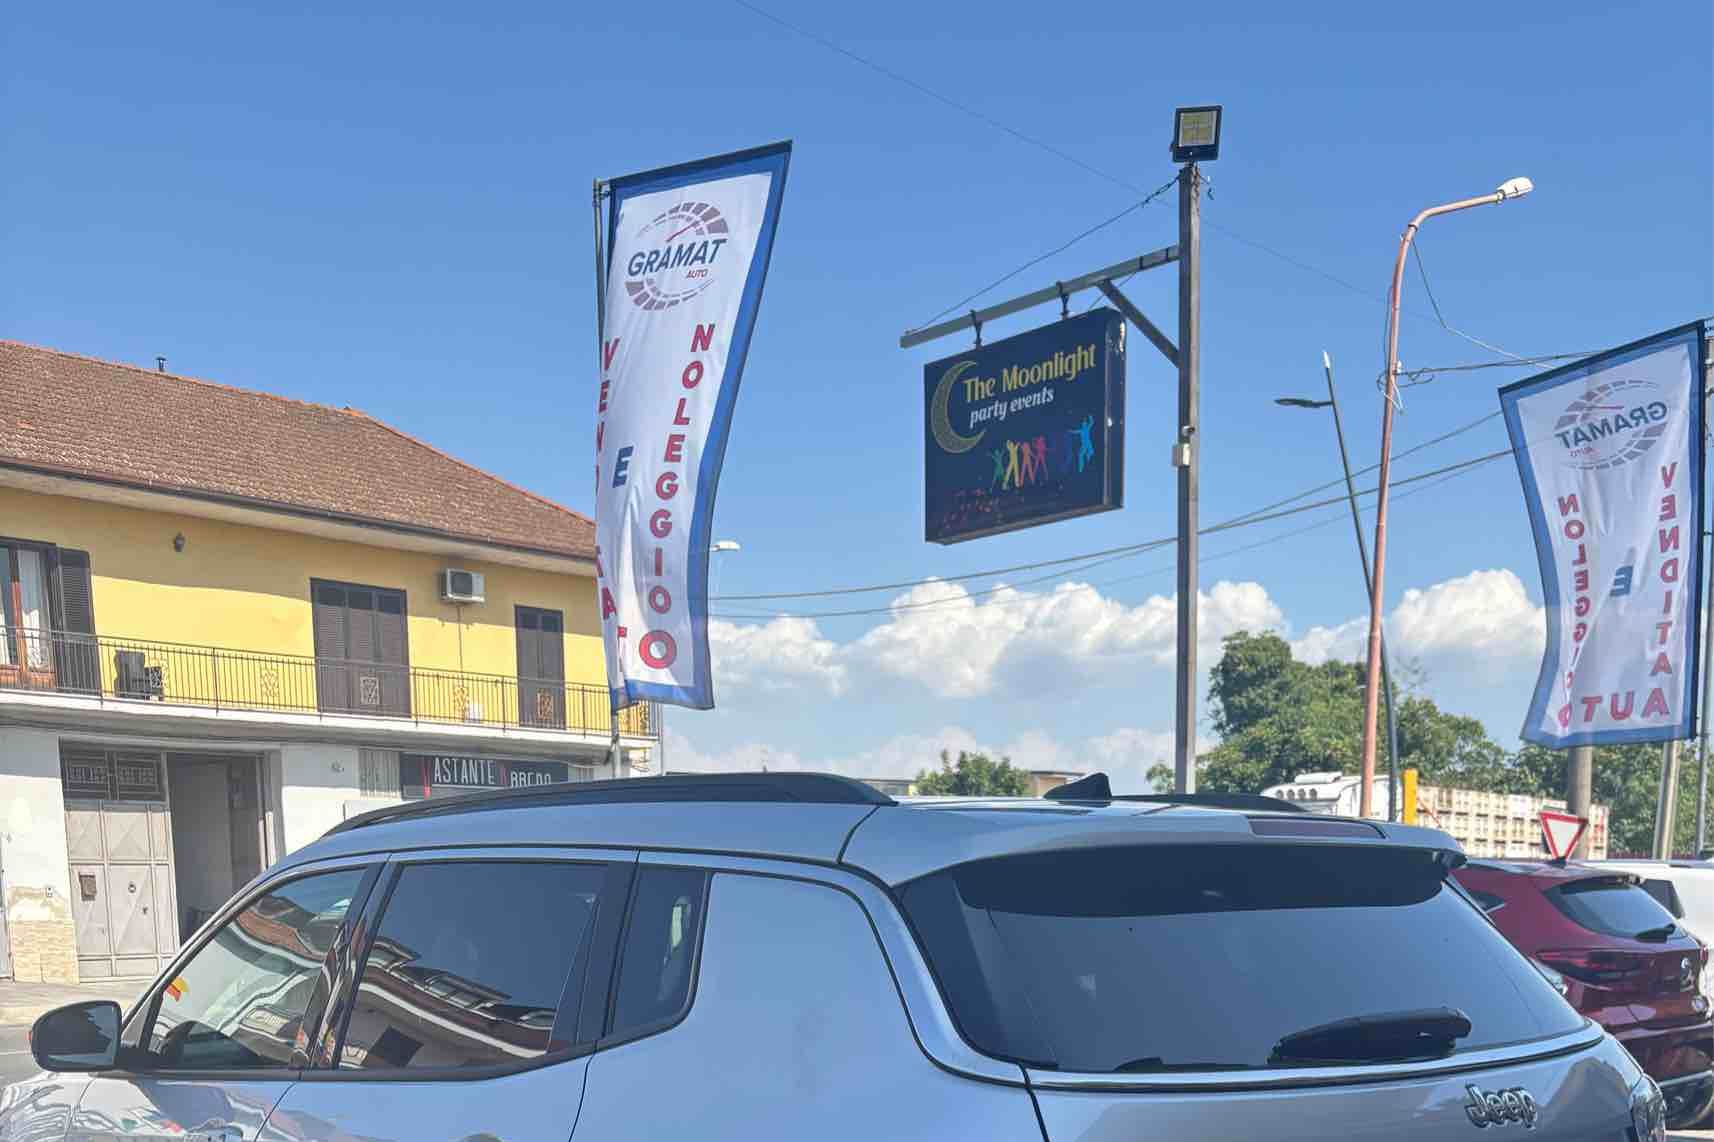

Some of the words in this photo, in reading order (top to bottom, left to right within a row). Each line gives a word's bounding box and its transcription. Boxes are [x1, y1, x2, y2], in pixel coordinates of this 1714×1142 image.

[627, 238, 727, 277] GRAMAT
[686, 267, 709, 280] AUTO
[963, 376, 996, 403] The
[1001, 343, 1096, 392] Moonlight
[970, 399, 1009, 429] party
[1010, 386, 1054, 413] events
[611, 445, 634, 488] E
[647, 323, 715, 614] NOLEGGIO
[1464, 1083, 1538, 1129] Jeep
